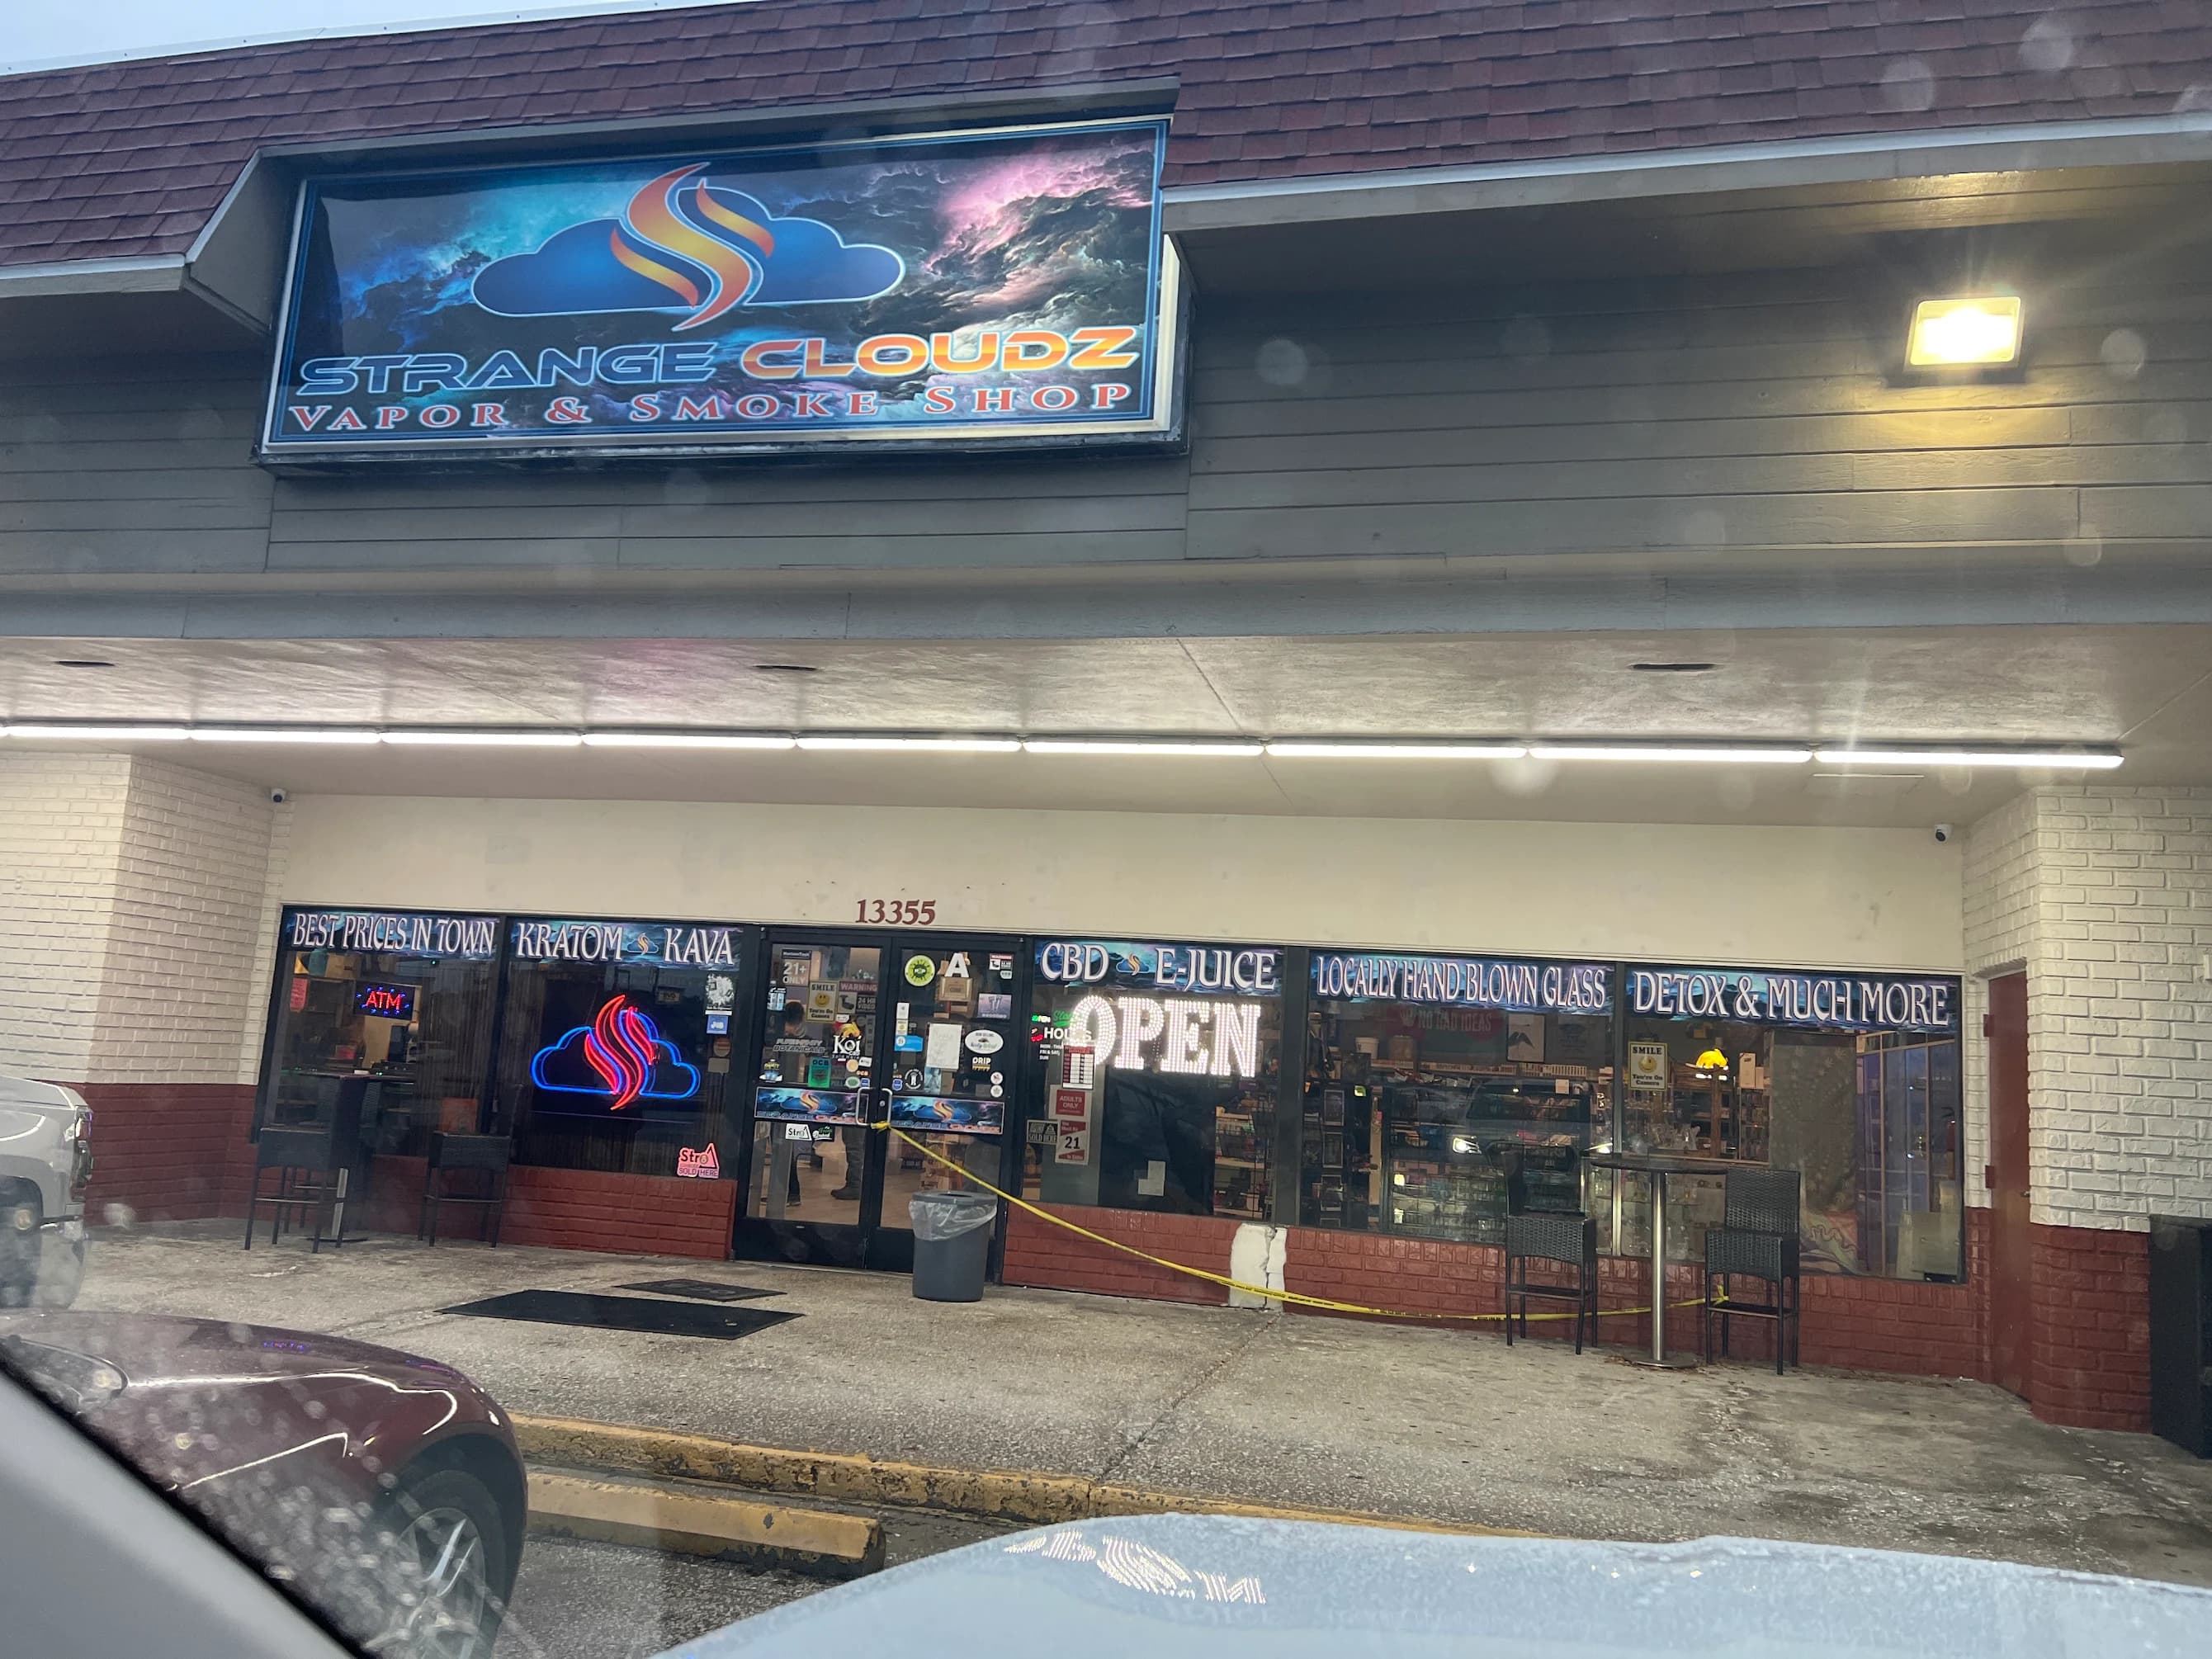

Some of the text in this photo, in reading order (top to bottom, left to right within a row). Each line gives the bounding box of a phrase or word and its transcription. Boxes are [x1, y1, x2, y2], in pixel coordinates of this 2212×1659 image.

[296, 325, 1140, 396] STRANGE CLOUDZ
[289, 383, 1132, 432] VAPOR & SMOKE SHOP
[855, 899, 937, 925] 13355
[293, 913, 495, 956] BEST PRICES IN TOWN
[516, 922, 735, 966] KRATOM KAVA
[783, 962, 807, 976] 21+
[944, 952, 970, 978] A
[1041, 942, 1278, 990] CBD E-JUICE
[782, 976, 807, 985] ONLY
[811, 983, 836, 991] SMILE
[841, 983, 878, 991] WARNING
[1317, 956, 1606, 1009] LOCALLY HAND BLOWN GLASS
[365, 991, 403, 1010] ATM
[1633, 971, 1949, 1027] DETOX & MUCH MORE
[831, 1034, 862, 1054] Koi
[1043, 1027, 1092, 1040] HOUS
[1070, 995, 1261, 1078] OPEN
[1632, 1046, 1662, 1055] SMILE
[1065, 1136, 1080, 1150] 21
[678, 1167, 718, 1177] SOLD HERE
